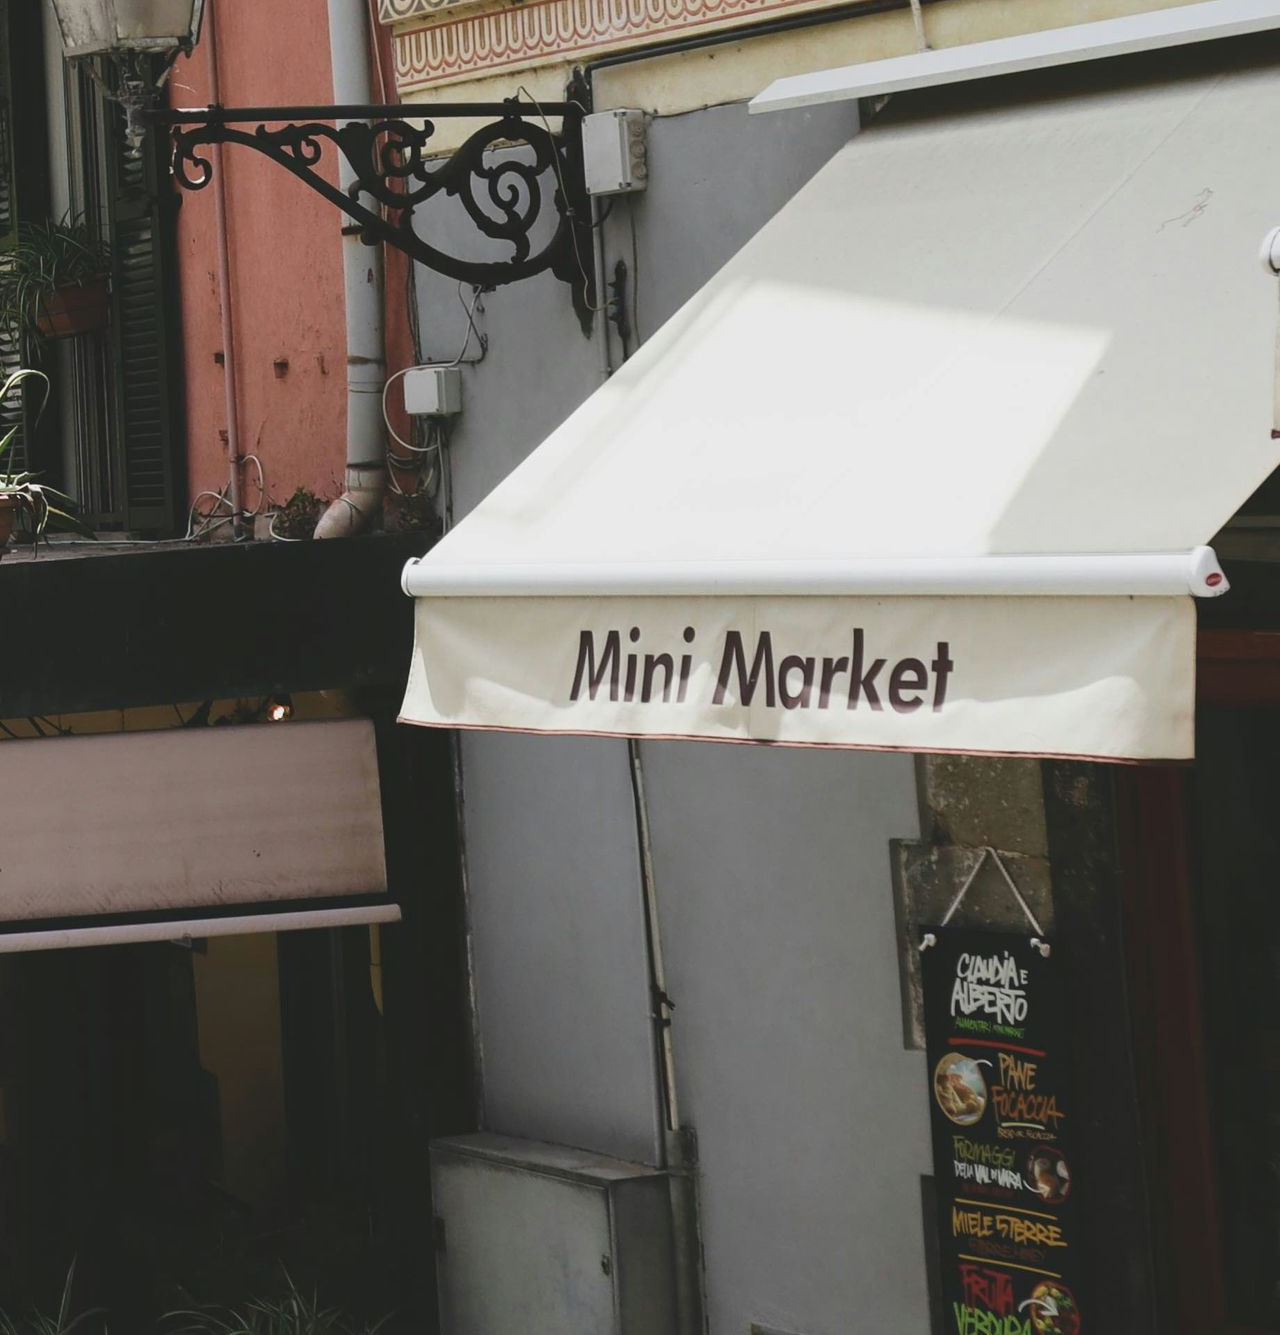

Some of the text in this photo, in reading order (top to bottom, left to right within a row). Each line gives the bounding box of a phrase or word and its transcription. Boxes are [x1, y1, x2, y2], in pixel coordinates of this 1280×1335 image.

[569, 625, 954, 714] Mini Market
[1020, 969, 1030, 985] E
[950, 978, 1029, 1025] ALBERTO
[997, 1052, 1039, 1091] PANE
[991, 1085, 1066, 1127] FOCACCIA
[952, 1135, 1016, 1168] FORMAGGI
[974, 1163, 992, 1185] VAL
[952, 1205, 995, 1238] MIELE
